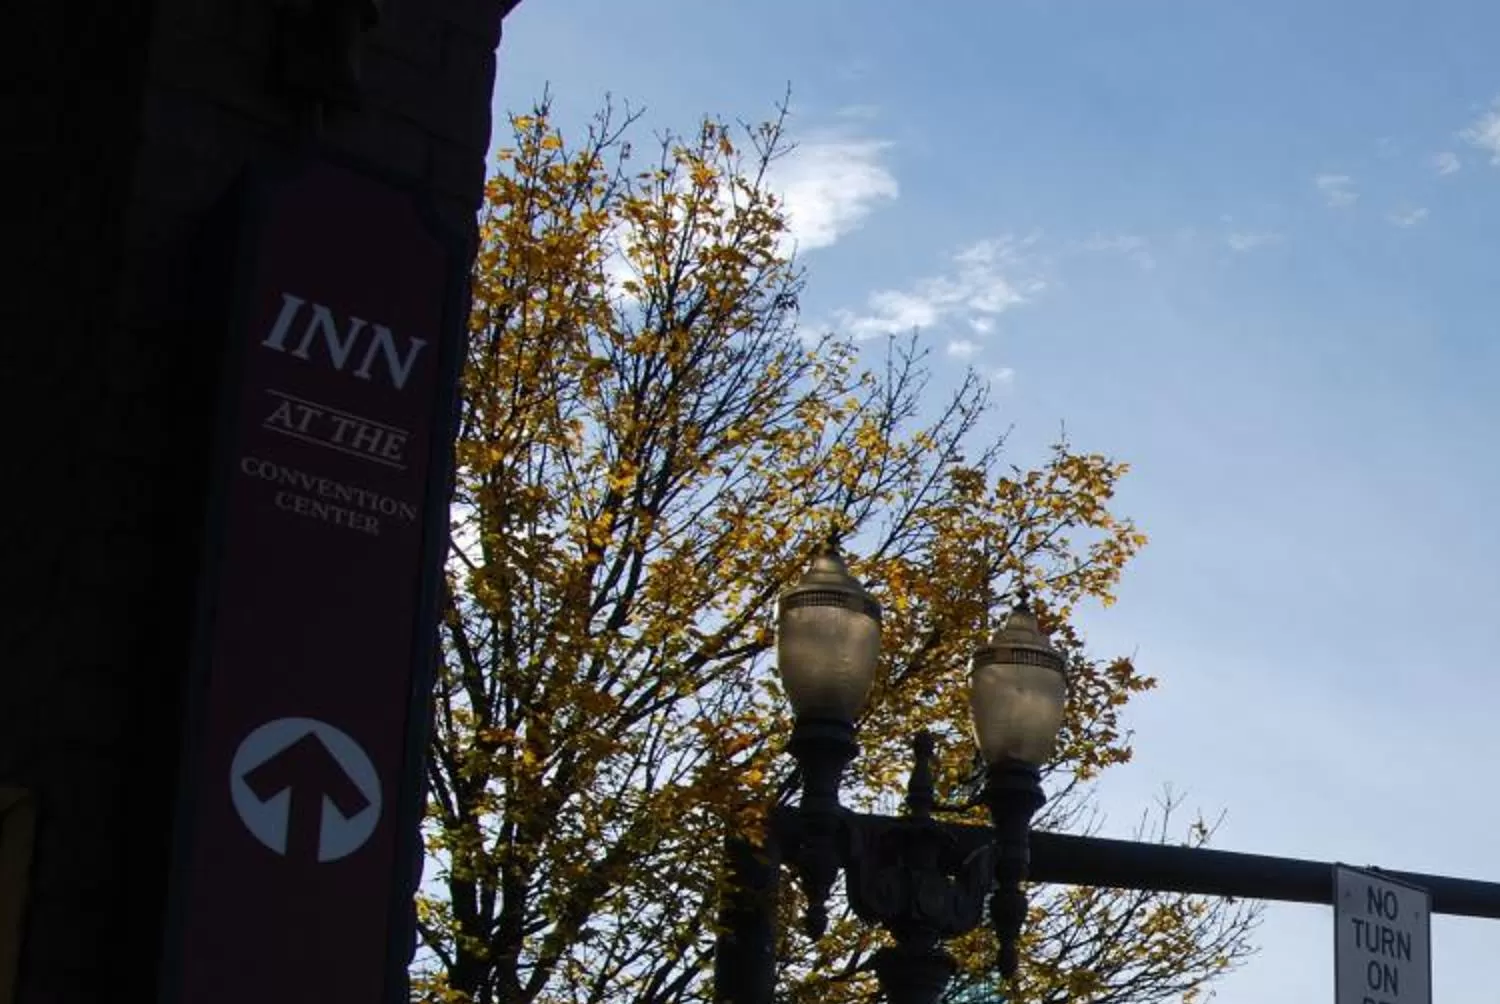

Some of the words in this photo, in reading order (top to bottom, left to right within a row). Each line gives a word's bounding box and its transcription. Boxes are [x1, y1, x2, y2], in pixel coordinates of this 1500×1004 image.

[261, 291, 427, 392] INN
[264, 399, 325, 434] AT
[330, 412, 409, 461] THE
[240, 455, 418, 523] CONVENTION
[274, 490, 381, 536] CENTER
[1366, 885, 1399, 922] NO
[1351, 919, 1412, 962] TURN
[1367, 959, 1399, 996] ON
